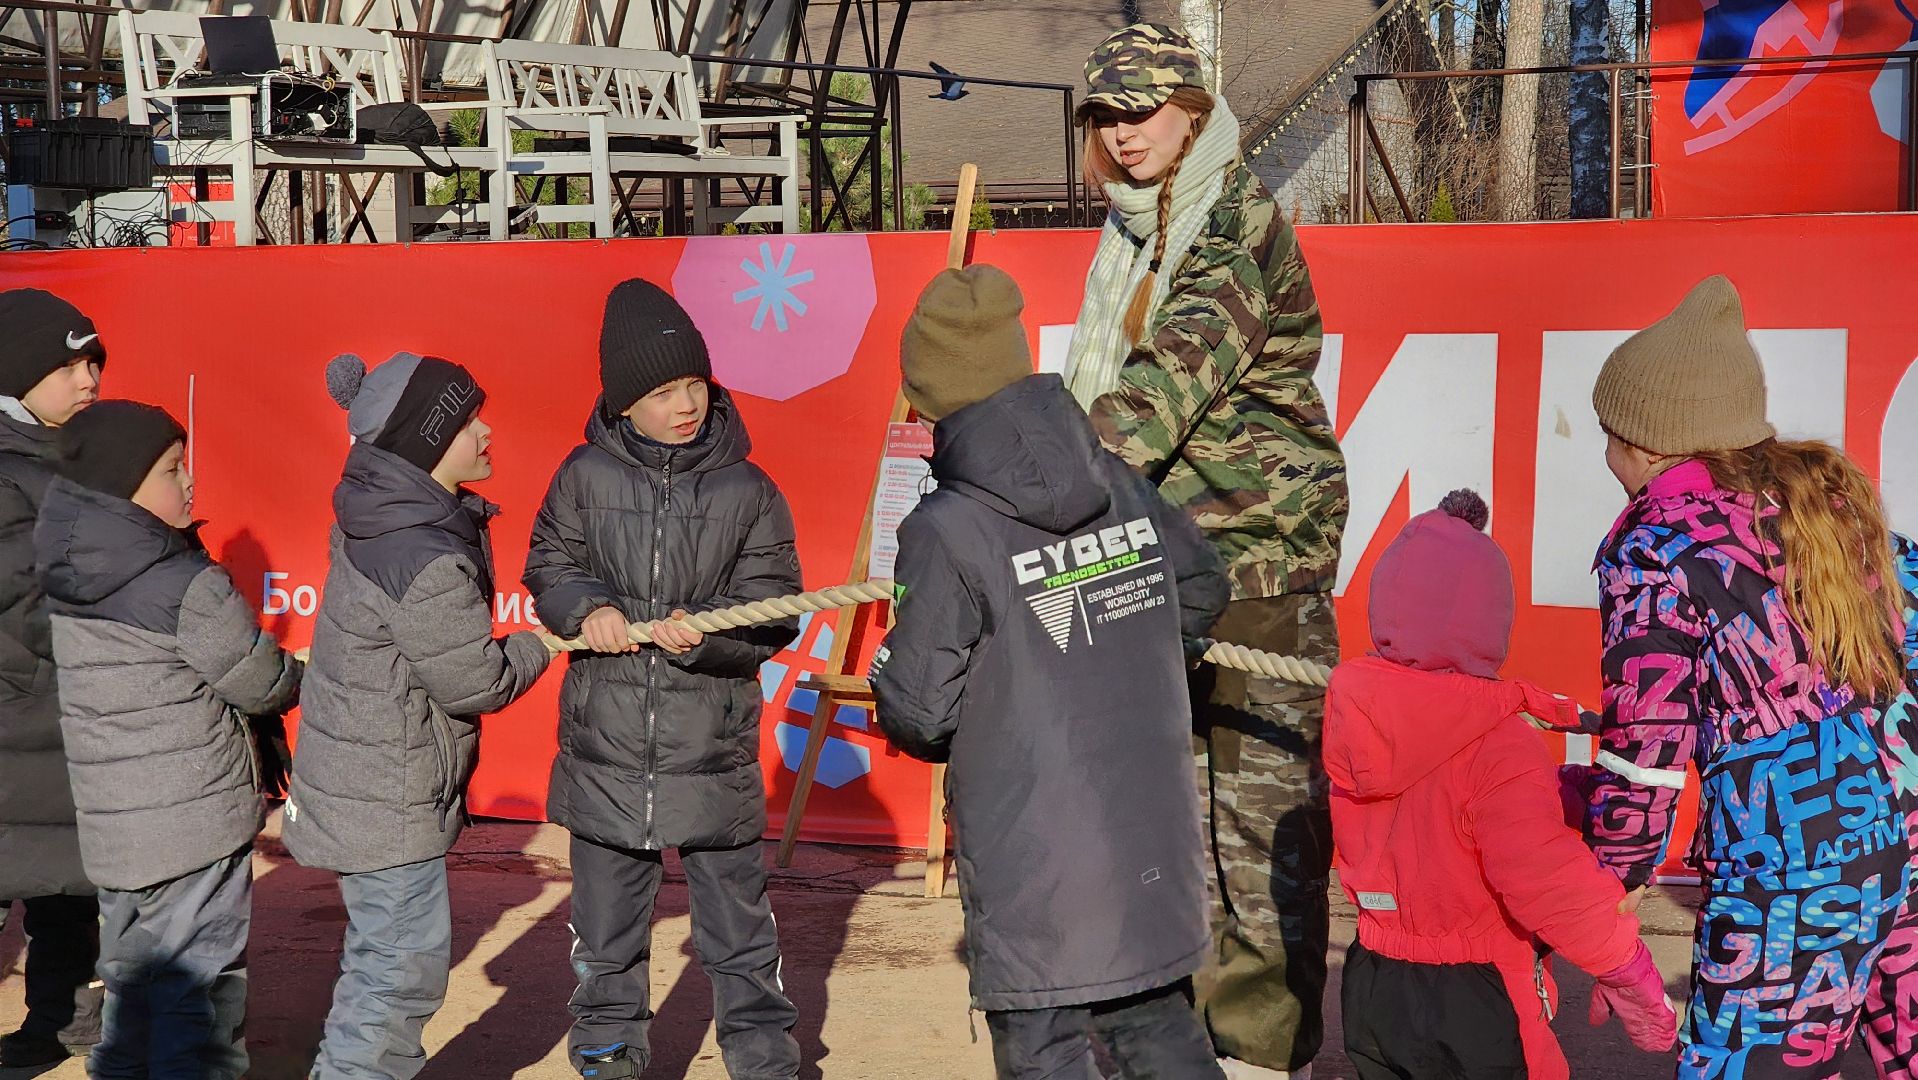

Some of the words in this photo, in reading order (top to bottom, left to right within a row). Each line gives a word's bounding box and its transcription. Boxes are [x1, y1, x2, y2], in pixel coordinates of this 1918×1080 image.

[420, 374, 475, 446] FIL
[1086, 580, 1136, 603] ESTABLISHED
[1136, 576, 1146, 588] IN
[1146, 572, 1164, 585] 1995
[1105, 593, 1134, 610] WORLD
[1133, 587, 1151, 601] CITY
[1097, 614, 1104, 624] IT
[1144, 597, 1156, 610] AW
[1156, 594, 1165, 606] 23
[1813, 811, 1908, 869] ACTIV
